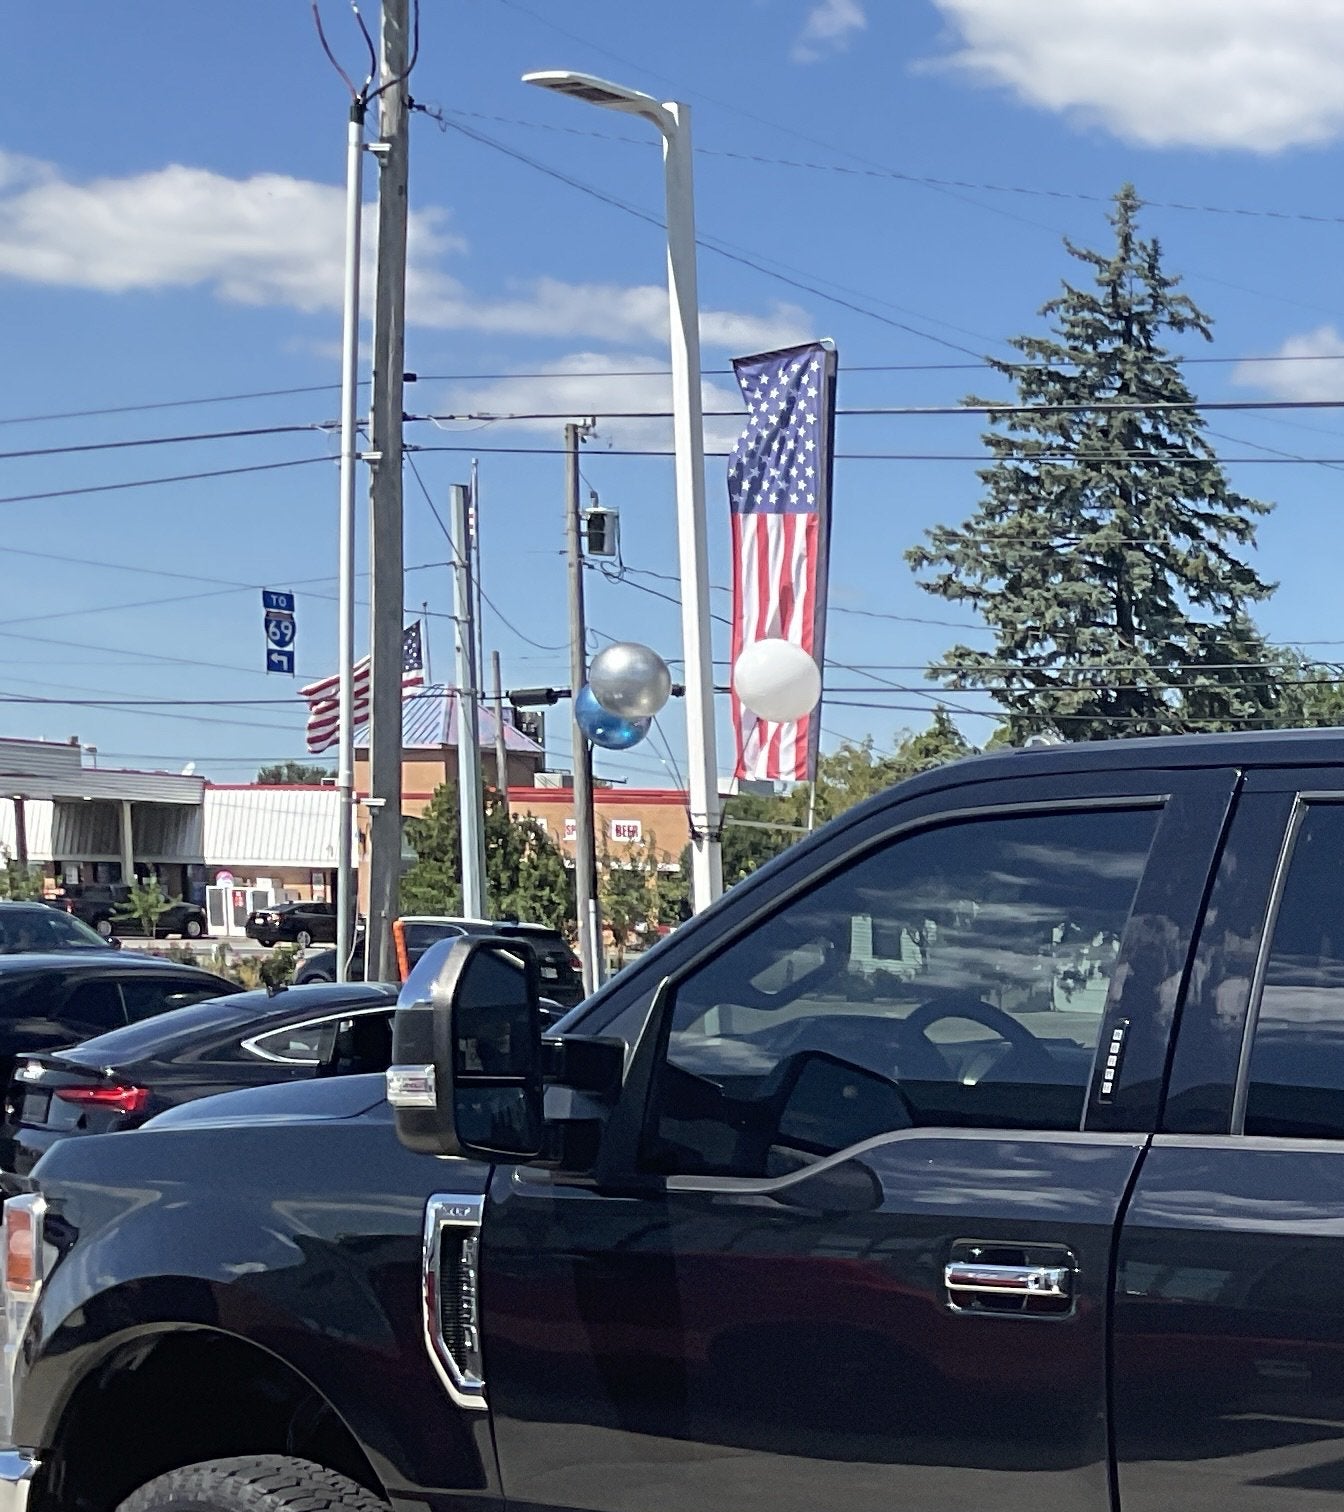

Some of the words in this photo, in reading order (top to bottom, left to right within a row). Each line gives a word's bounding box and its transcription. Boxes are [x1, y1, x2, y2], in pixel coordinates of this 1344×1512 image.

[271, 594, 287, 607] TO
[268, 620, 293, 642] 69
[615, 824, 639, 838] BEER
